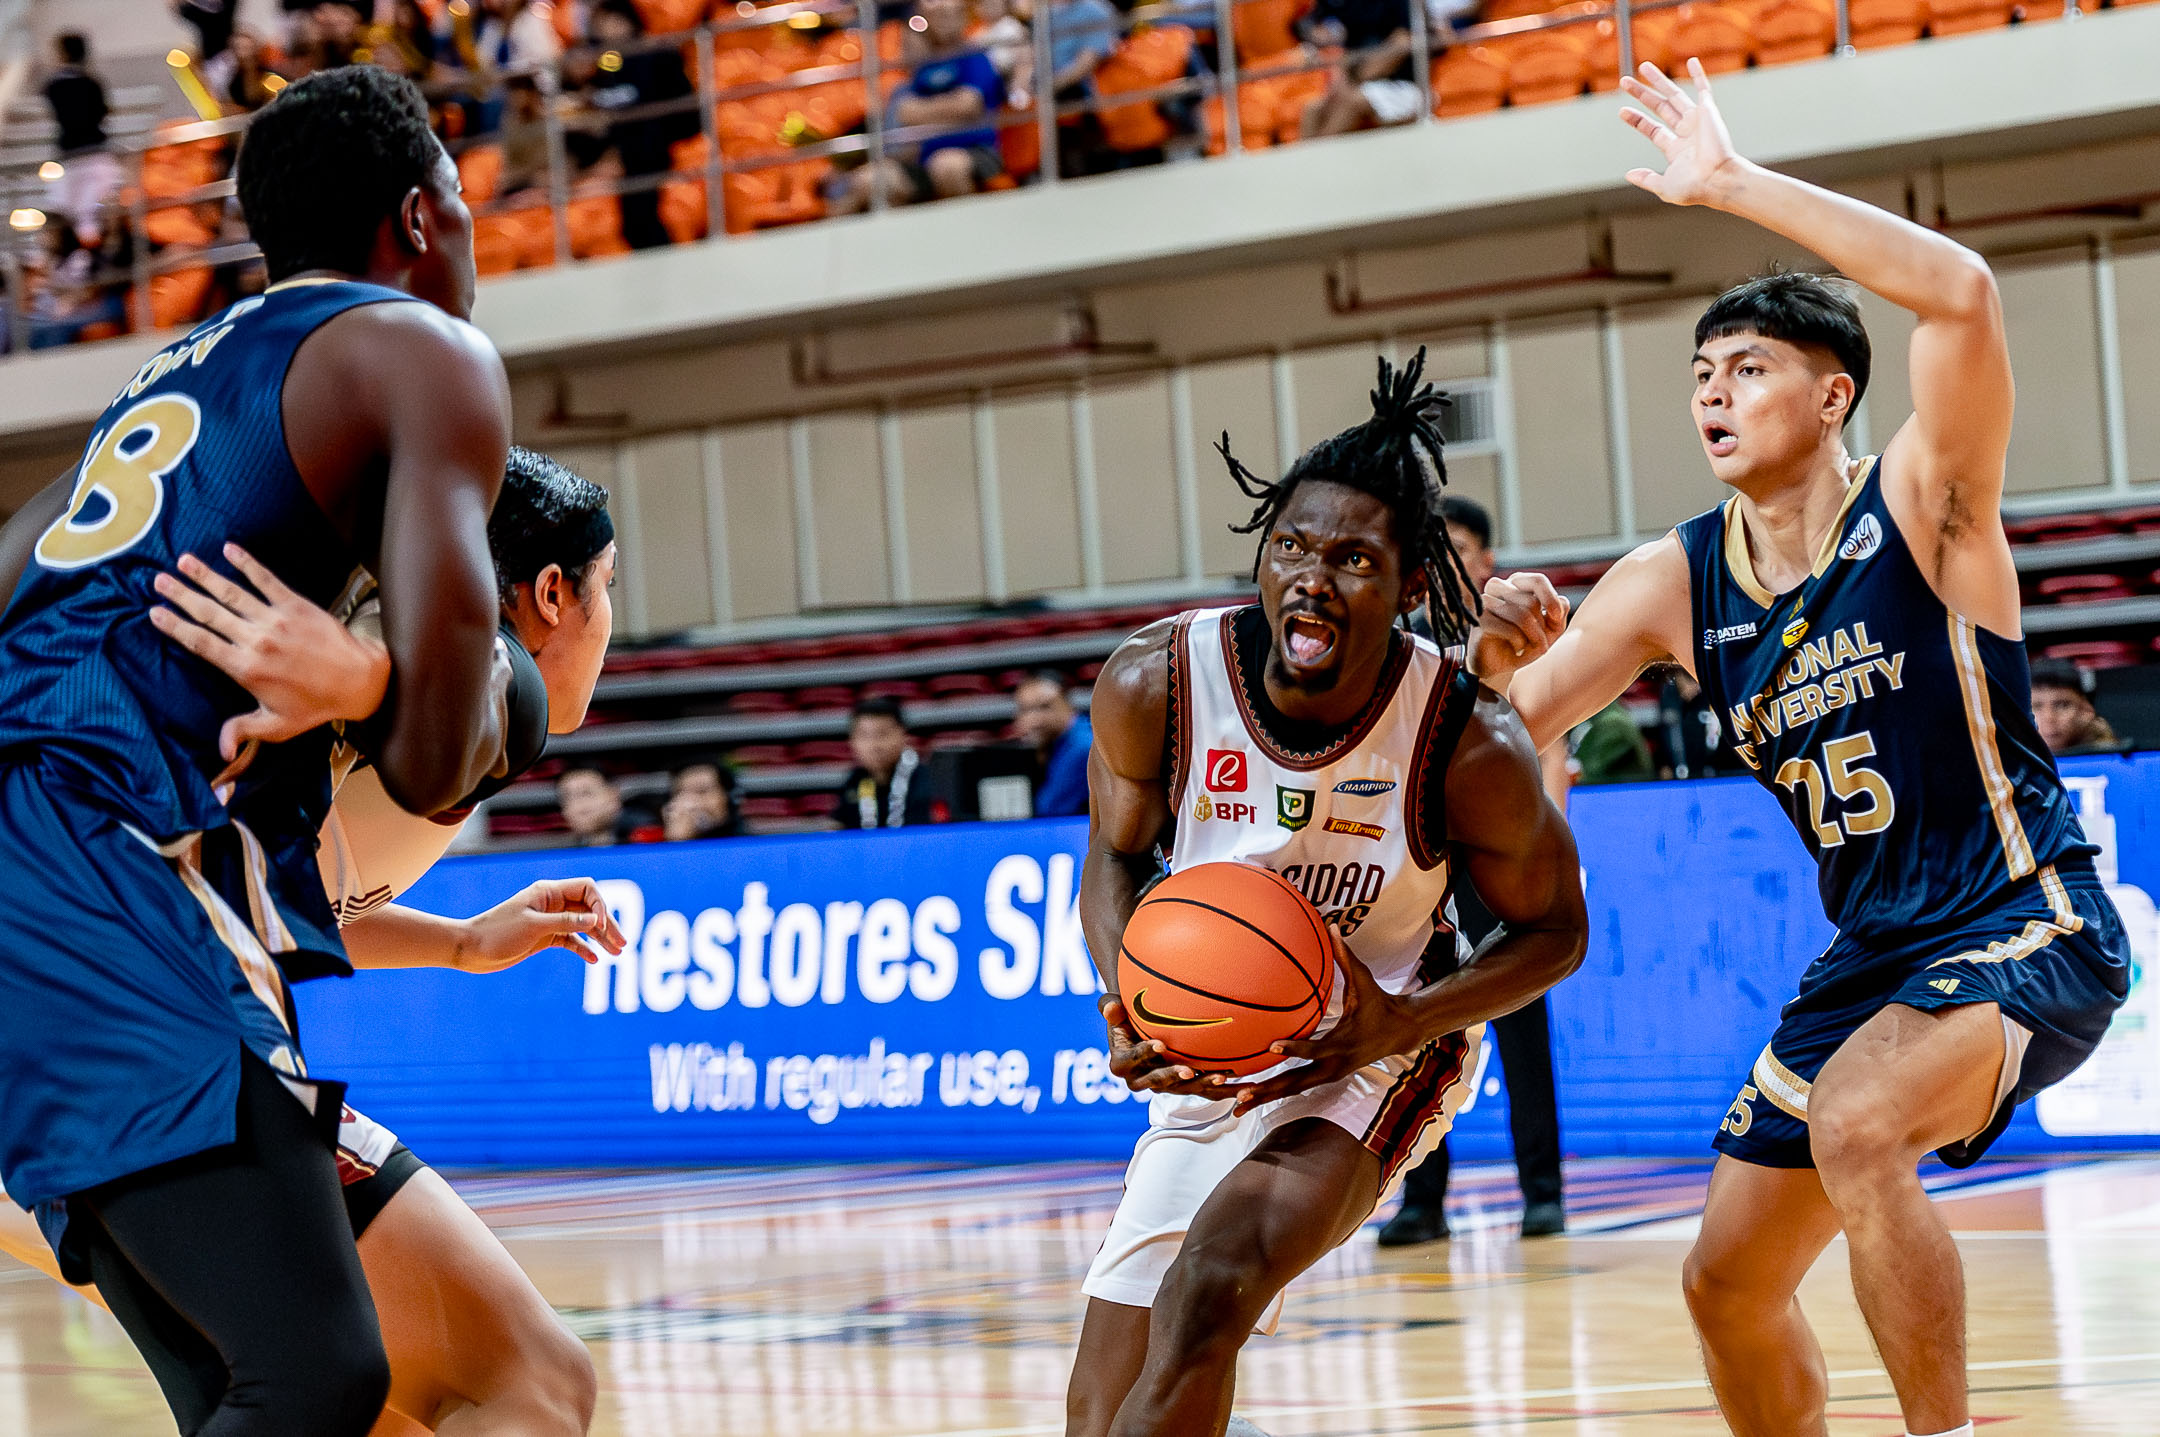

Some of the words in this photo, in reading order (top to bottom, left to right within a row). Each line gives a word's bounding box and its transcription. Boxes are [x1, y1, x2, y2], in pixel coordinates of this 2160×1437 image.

[34, 393, 201, 571] 8
[1717, 621, 1757, 641] DATEM
[1215, 802, 1258, 824] BPI
[1336, 782, 1394, 793] CHAMPION
[1774, 730, 1896, 849] 25
[1264, 861, 1386, 907] SIDAD
[582, 878, 962, 1014] Restores
[978, 852, 1107, 1000] Sk
[649, 1041, 757, 1113] With
[764, 1036, 934, 1125] regular
[938, 1049, 1042, 1115] use,
[1051, 1047, 1152, 1105] res
